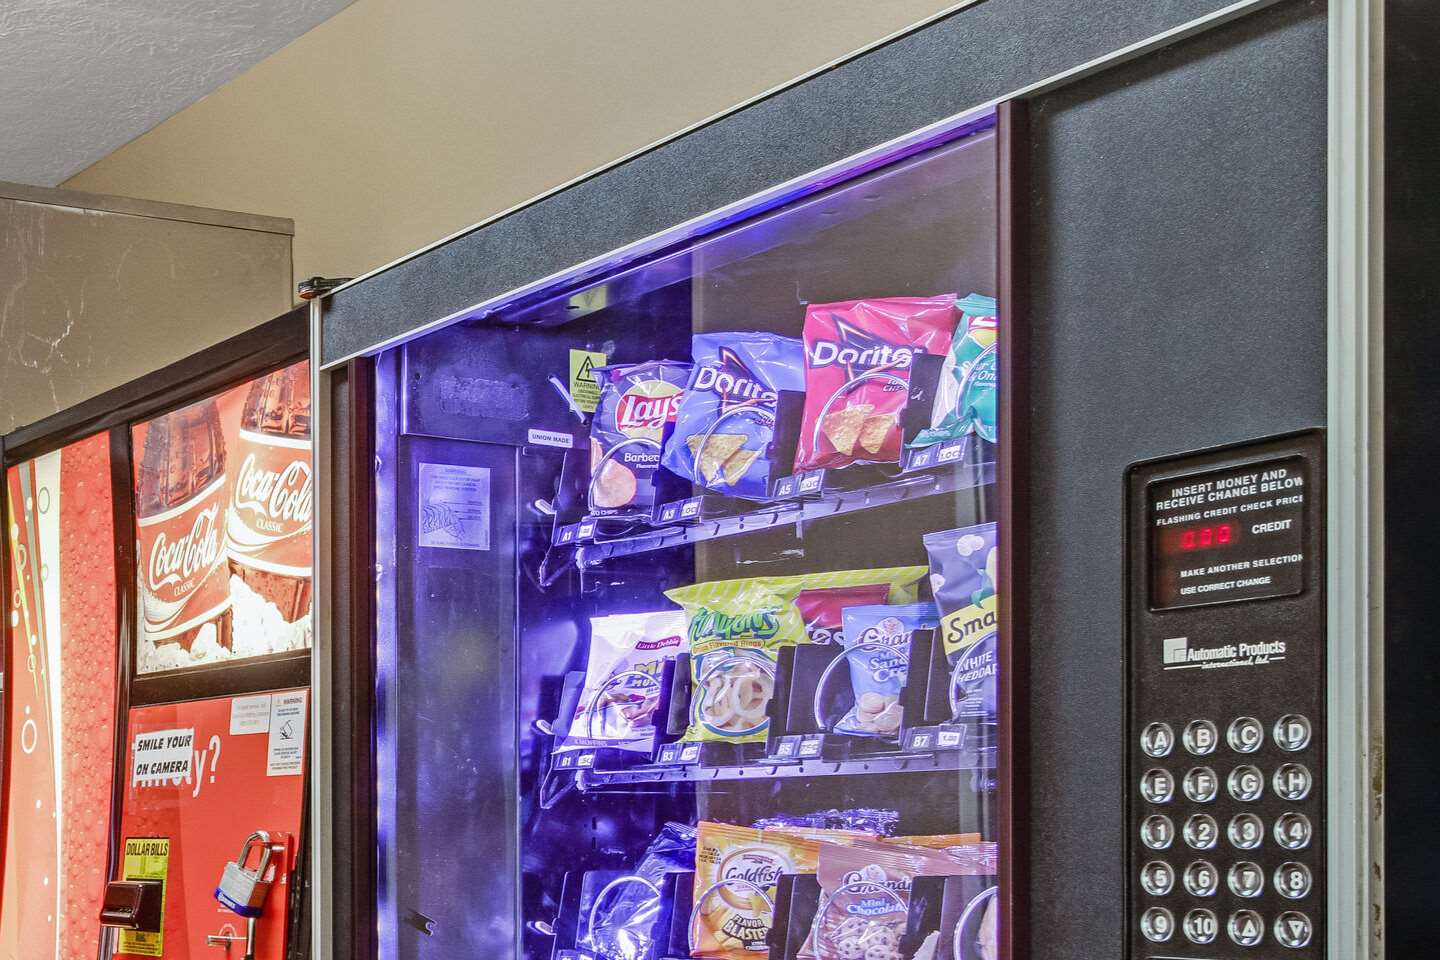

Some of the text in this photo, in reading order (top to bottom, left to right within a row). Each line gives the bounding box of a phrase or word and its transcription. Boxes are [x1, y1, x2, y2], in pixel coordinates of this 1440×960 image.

[531, 433, 570, 444] UNION MADE
[779, 484, 791, 496] A5
[1172, 469, 1287, 498] INSERT MONEY AND
[1156, 476, 1303, 511] RECEIVE CHANGE BELOW
[1156, 511, 1201, 526] FLASHING
[1203, 505, 1238, 519] CREDIT
[1240, 499, 1273, 512] CHECK
[1252, 519, 1292, 534] CREDIT
[1180, 568, 1205, 578] MAKE
[1207, 561, 1250, 574] ANOTHER
[1180, 576, 1271, 595] USE CORRECT CHANGE
[1187, 640, 1286, 662] Automatic Products
[137, 735, 192, 752] SMILE YOUR
[1154, 724, 1303, 748] A B C D
[136, 760, 188, 775] ON CAMERA
[1154, 773, 1303, 794] E F G H
[1198, 824, 1210, 840] 2
[1243, 822, 1255, 840] 3
[1290, 822, 1303, 839] 4
[126, 843, 168, 856] DOLLAR BILLS
[1155, 870, 1303, 889] 5 6 7 8
[1155, 916, 1211, 934] 9 10
